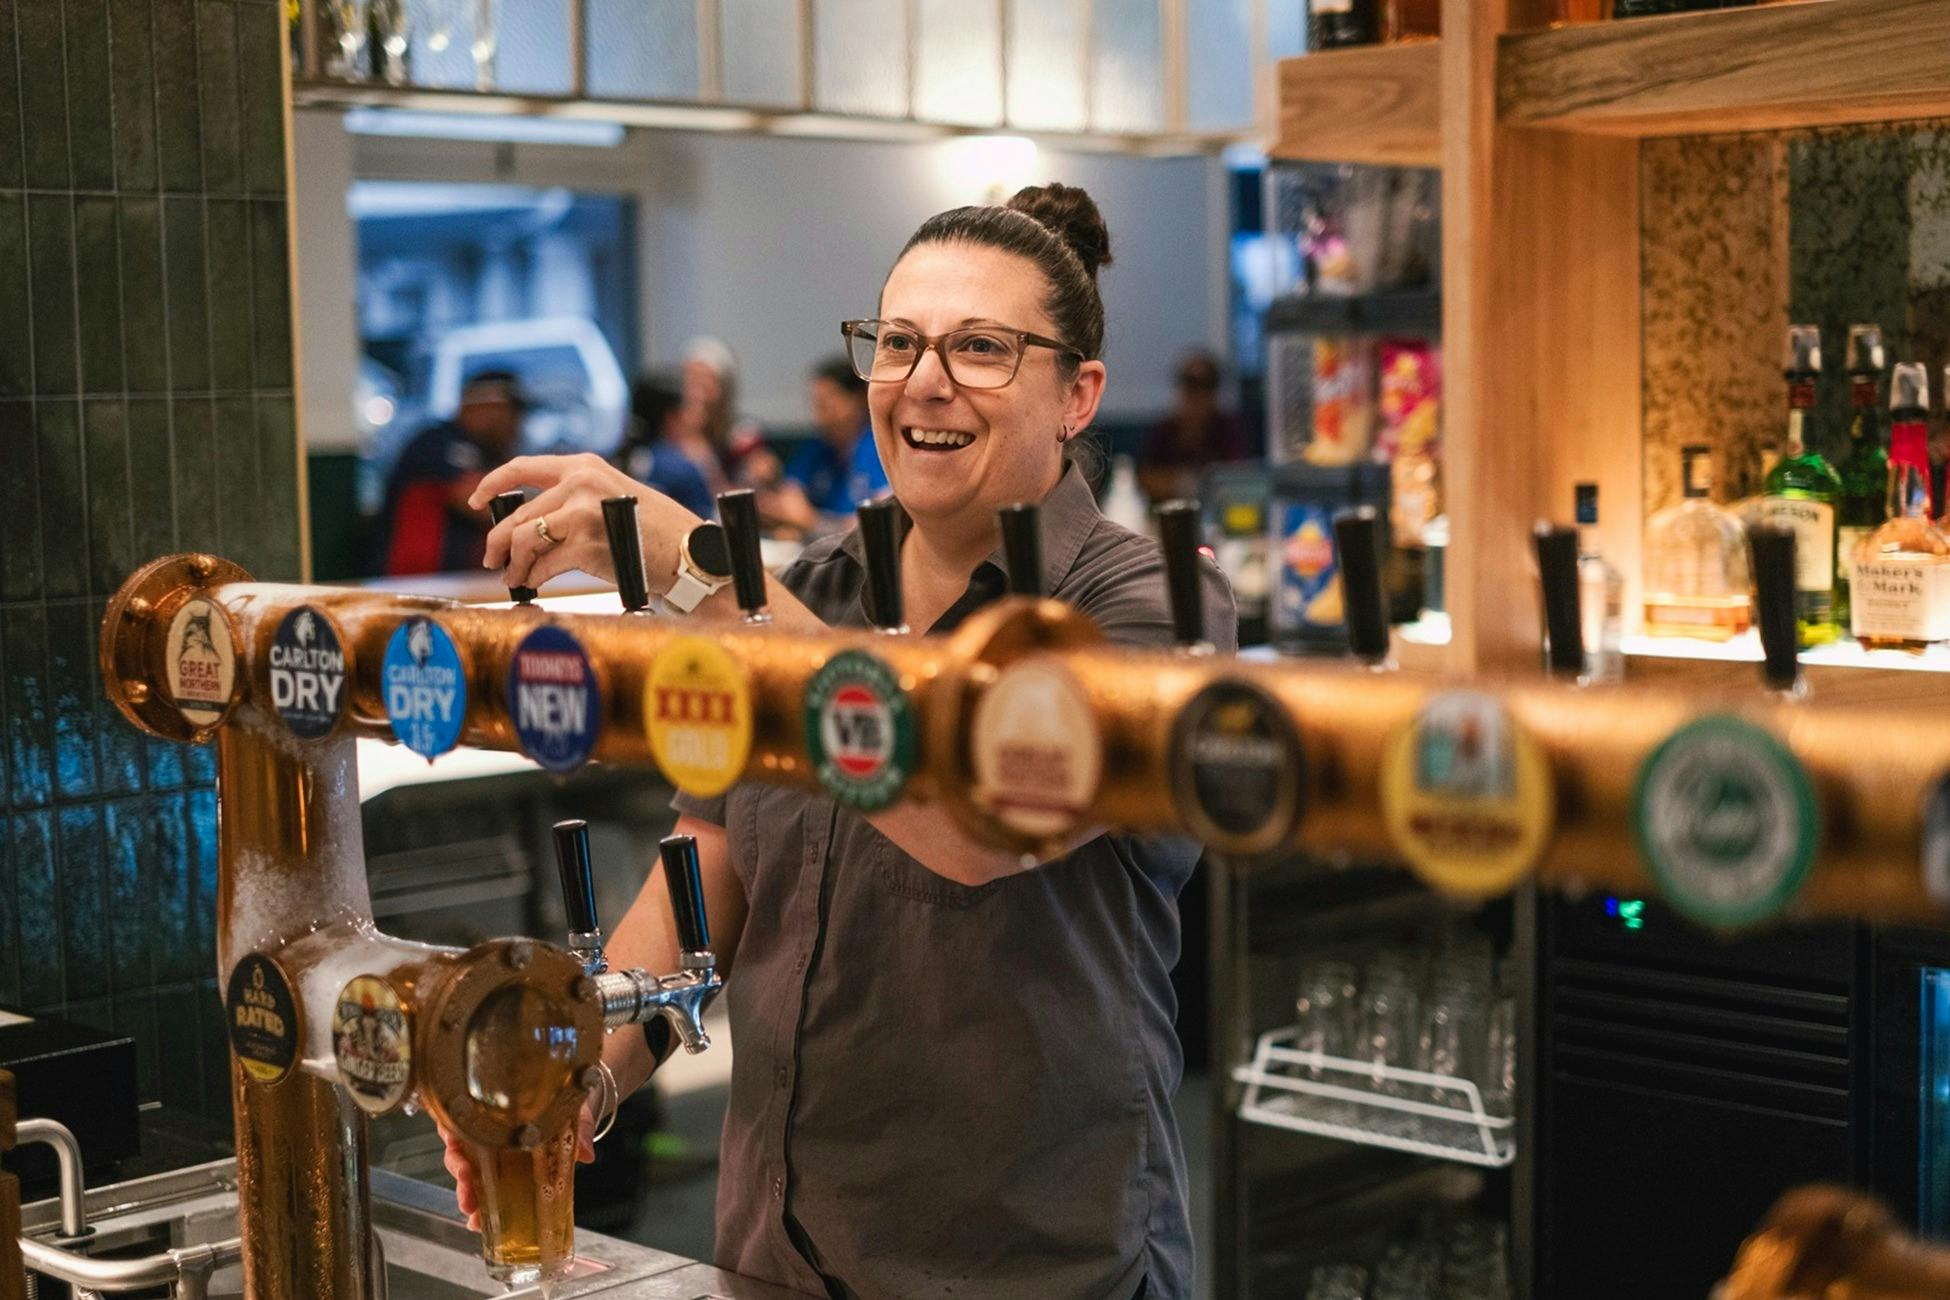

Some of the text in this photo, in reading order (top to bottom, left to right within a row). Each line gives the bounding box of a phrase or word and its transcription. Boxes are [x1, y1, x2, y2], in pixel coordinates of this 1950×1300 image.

[1857, 565, 1924, 579] Maker's
[1871, 582, 1923, 597] Mark
[180, 660, 220, 678] GREAT
[269, 645, 344, 673] CARLTON
[180, 677, 221, 692] NORTHERN
[388, 664, 457, 686] CARLTON
[269, 668, 345, 714] DRY
[389, 684, 457, 722] DRY
[517, 682, 588, 734] NEW
[655, 685, 737, 726] XXXX
[832, 709, 881, 750] VB
[243, 987, 277, 1010] HARD
[236, 1004, 286, 1038] RATED
